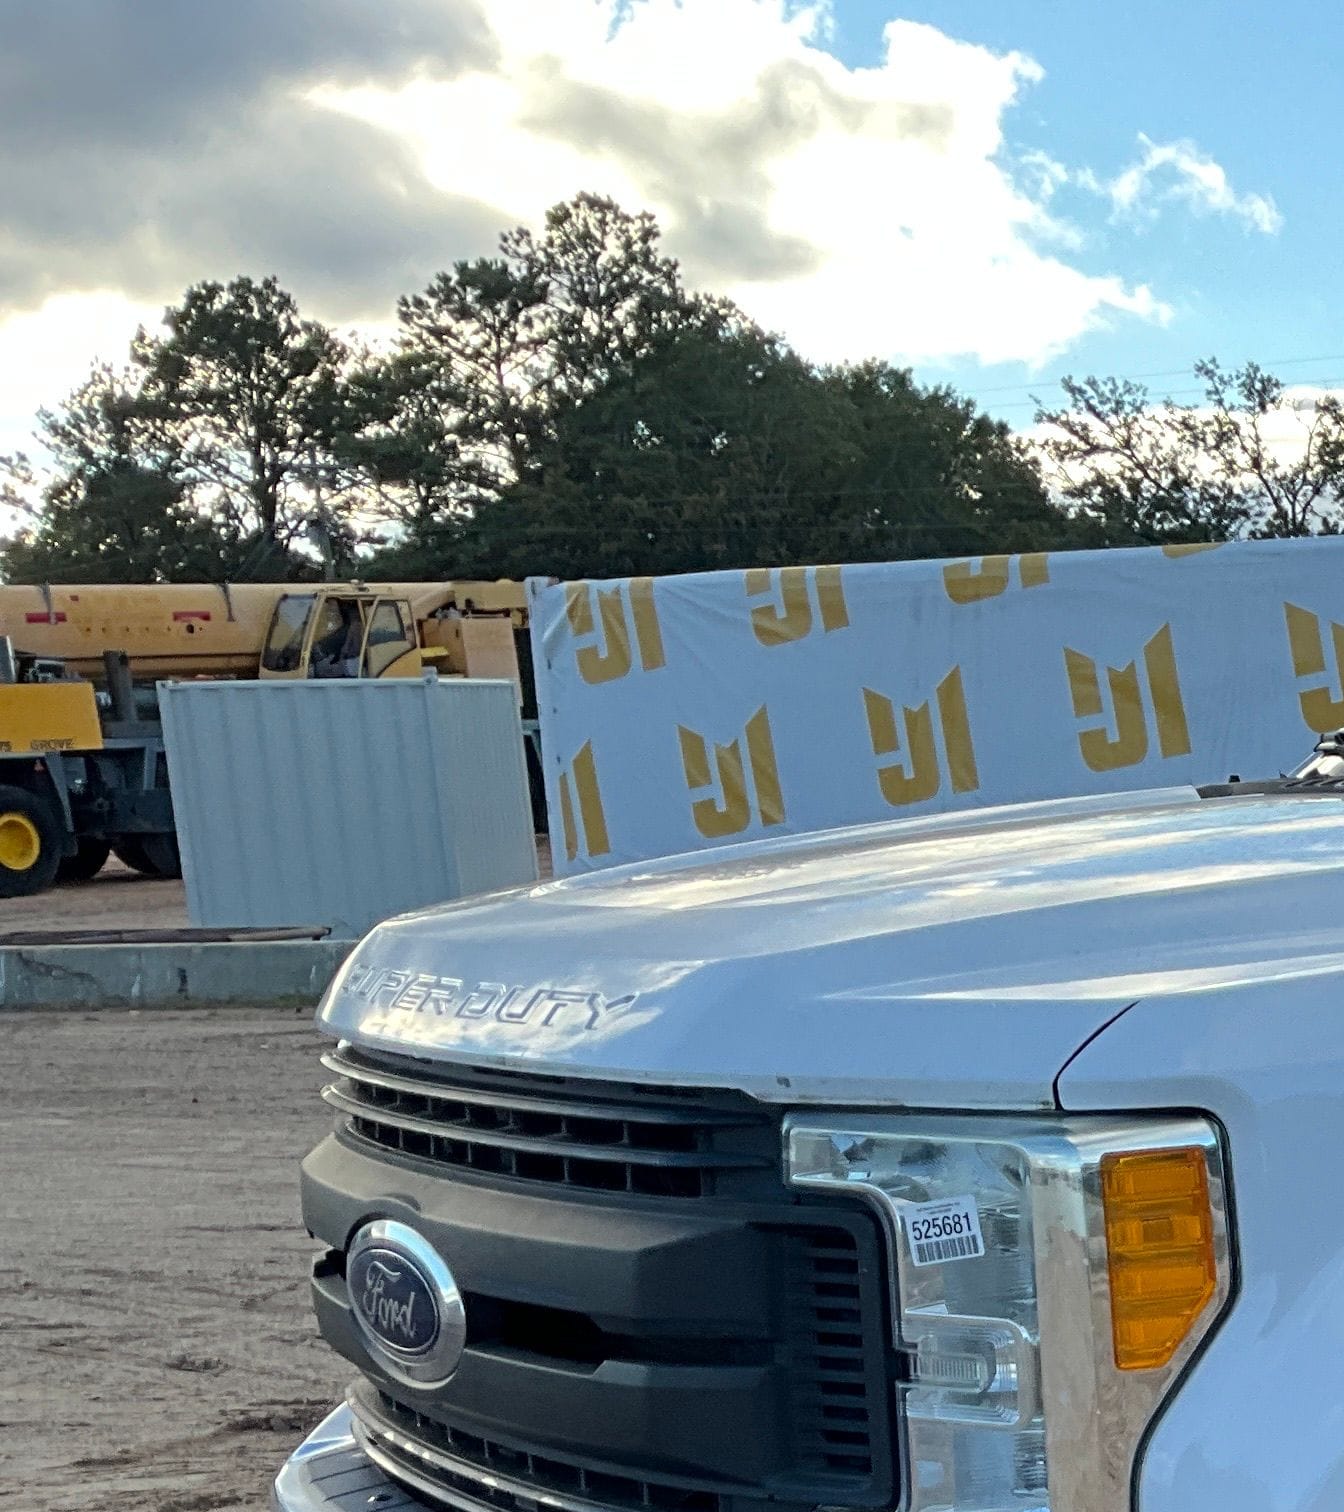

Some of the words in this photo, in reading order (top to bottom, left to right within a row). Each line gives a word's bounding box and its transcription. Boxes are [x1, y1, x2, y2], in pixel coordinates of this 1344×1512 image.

[455, 981, 640, 1031] DUTY
[912, 1211, 972, 1241] 525681
[363, 1260, 418, 1340] Ford
